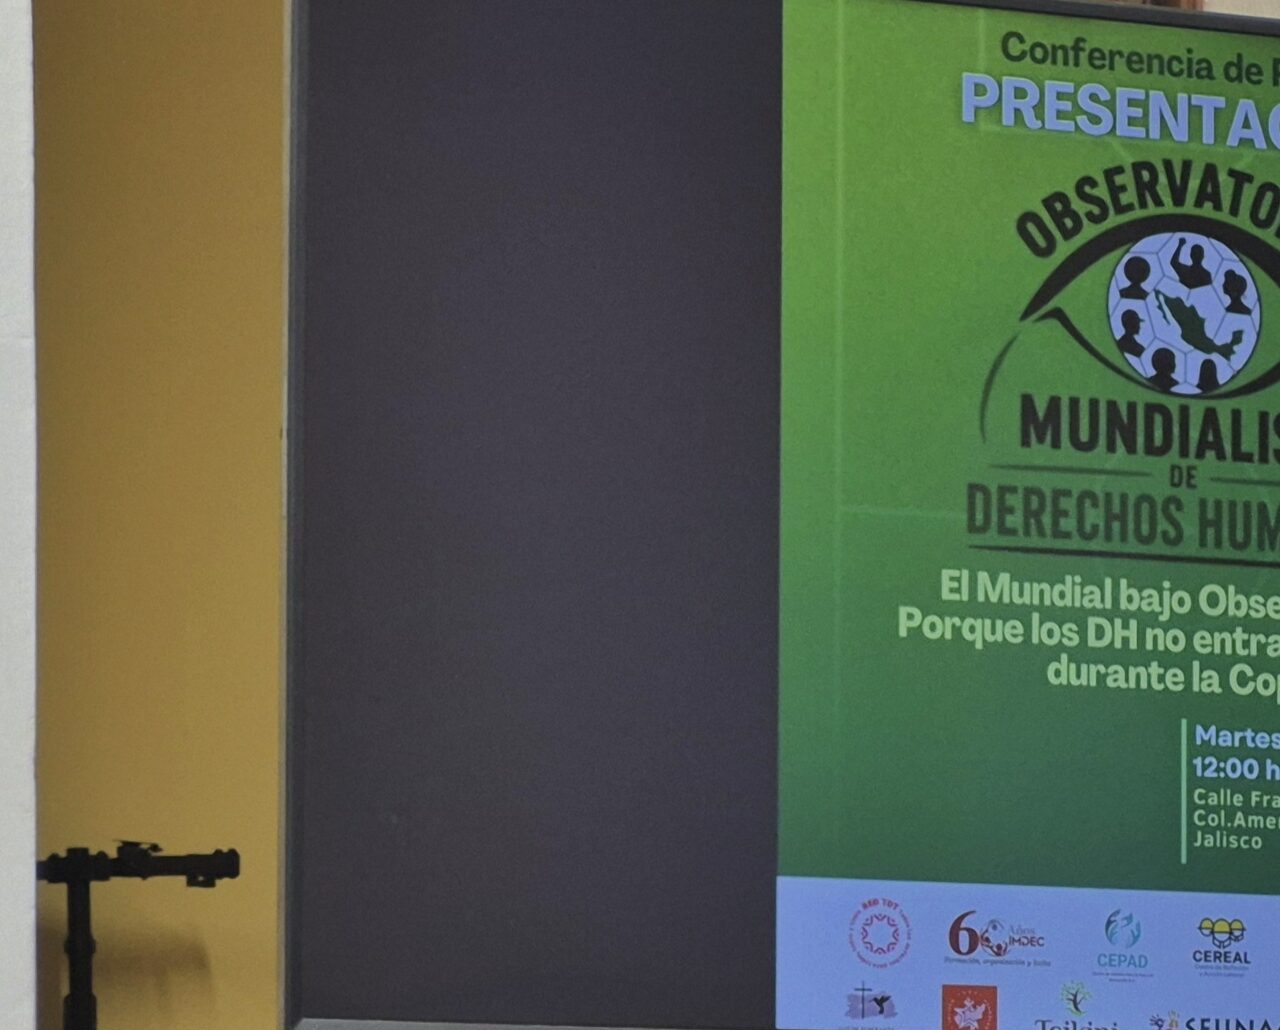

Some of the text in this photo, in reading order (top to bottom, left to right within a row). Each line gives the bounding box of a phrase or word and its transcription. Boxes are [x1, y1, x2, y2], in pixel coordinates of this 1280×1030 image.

[1001, 31, 1215, 82] Conferencia
[1222, 52, 1265, 87] de
[1169, 463, 1198, 490] DE
[966, 482, 1185, 549] DERECHOS
[940, 568, 969, 601] El
[976, 570, 1112, 610] Mundial
[1119, 577, 1192, 622] bajo
[898, 605, 1025, 650] Porque
[1031, 612, 1080, 647] los
[1087, 616, 1138, 651] DH
[1145, 626, 1187, 653] no
[1046, 653, 1186, 692] durante
[1191, 660, 1223, 695] la
[1192, 756, 1260, 780] 12:00
[1193, 788, 1244, 808] Calle
[1193, 830, 1263, 850] Jalisco
[1097, 953, 1149, 969] CEPAD
[1192, 950, 1252, 965] CEREAL
